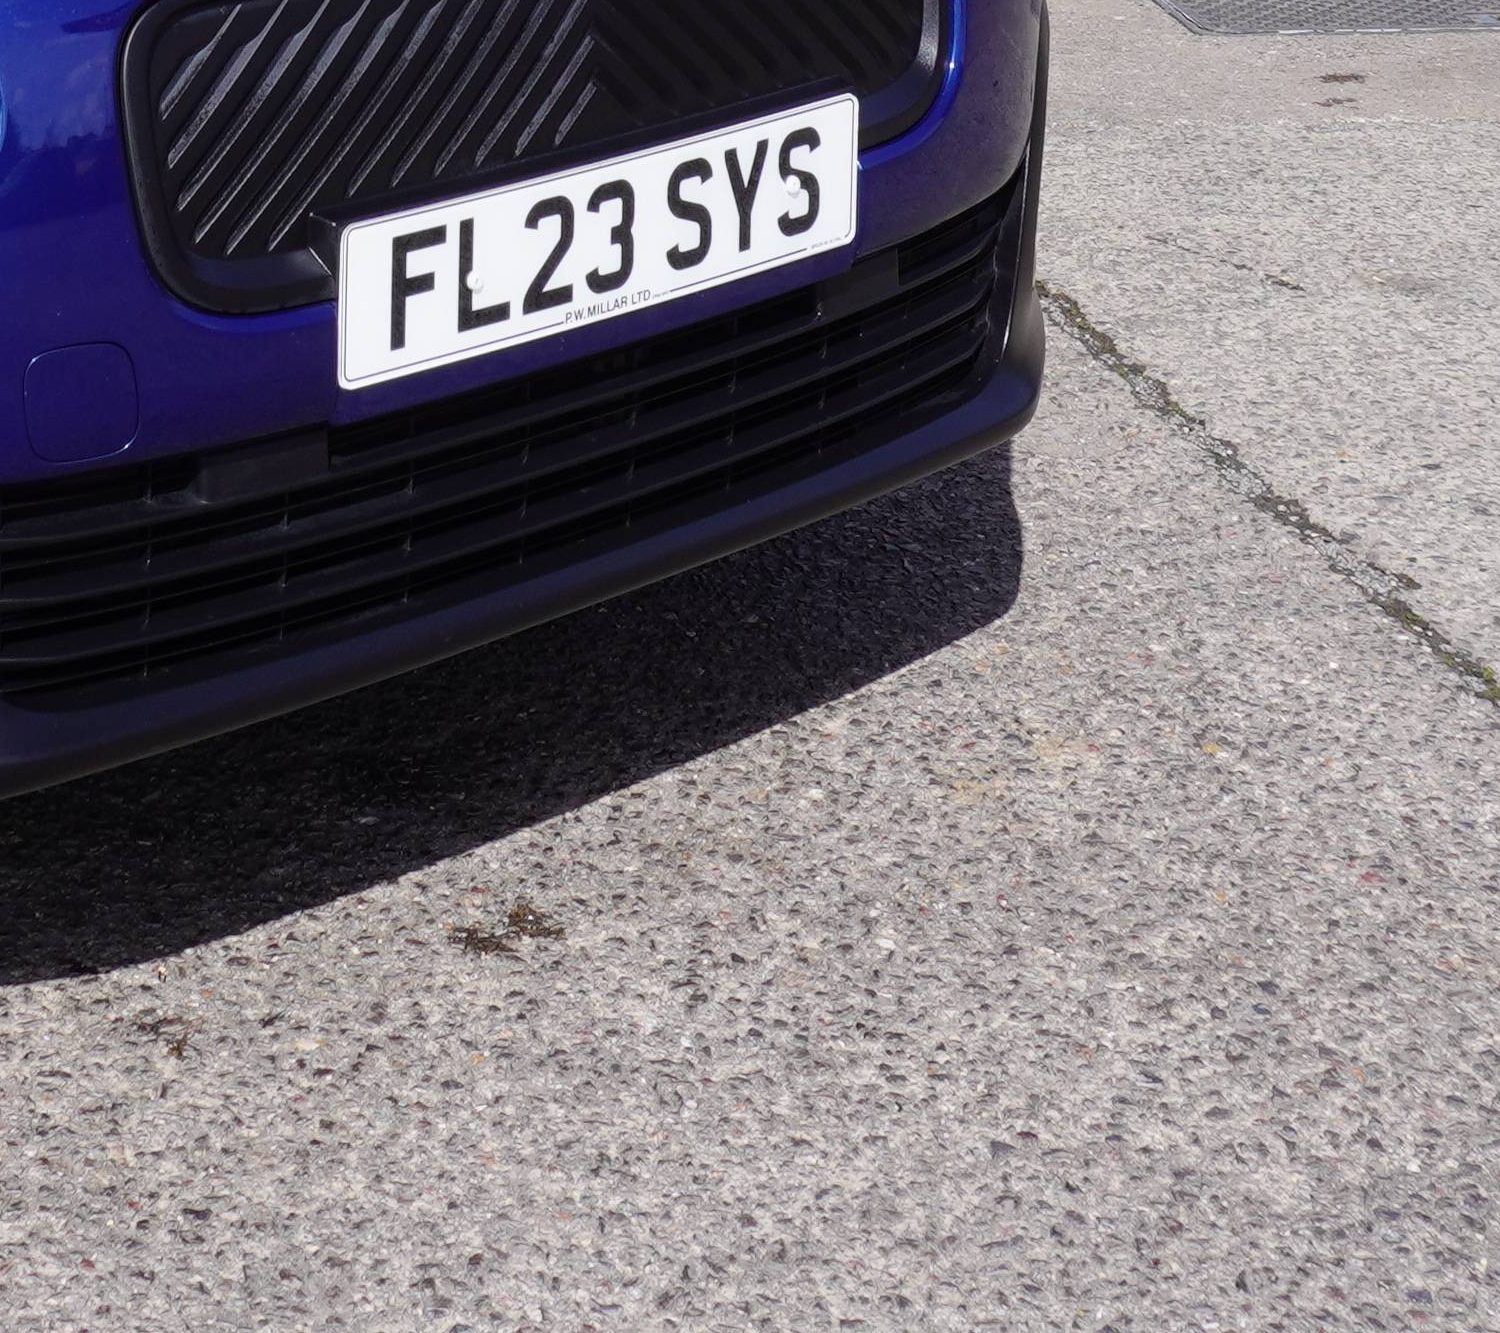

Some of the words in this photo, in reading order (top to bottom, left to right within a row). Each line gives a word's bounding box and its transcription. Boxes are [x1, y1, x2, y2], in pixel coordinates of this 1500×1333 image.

[390, 179, 635, 351] FL23
[666, 127, 821, 271] SYS
[631, 290, 651, 305] LTD
